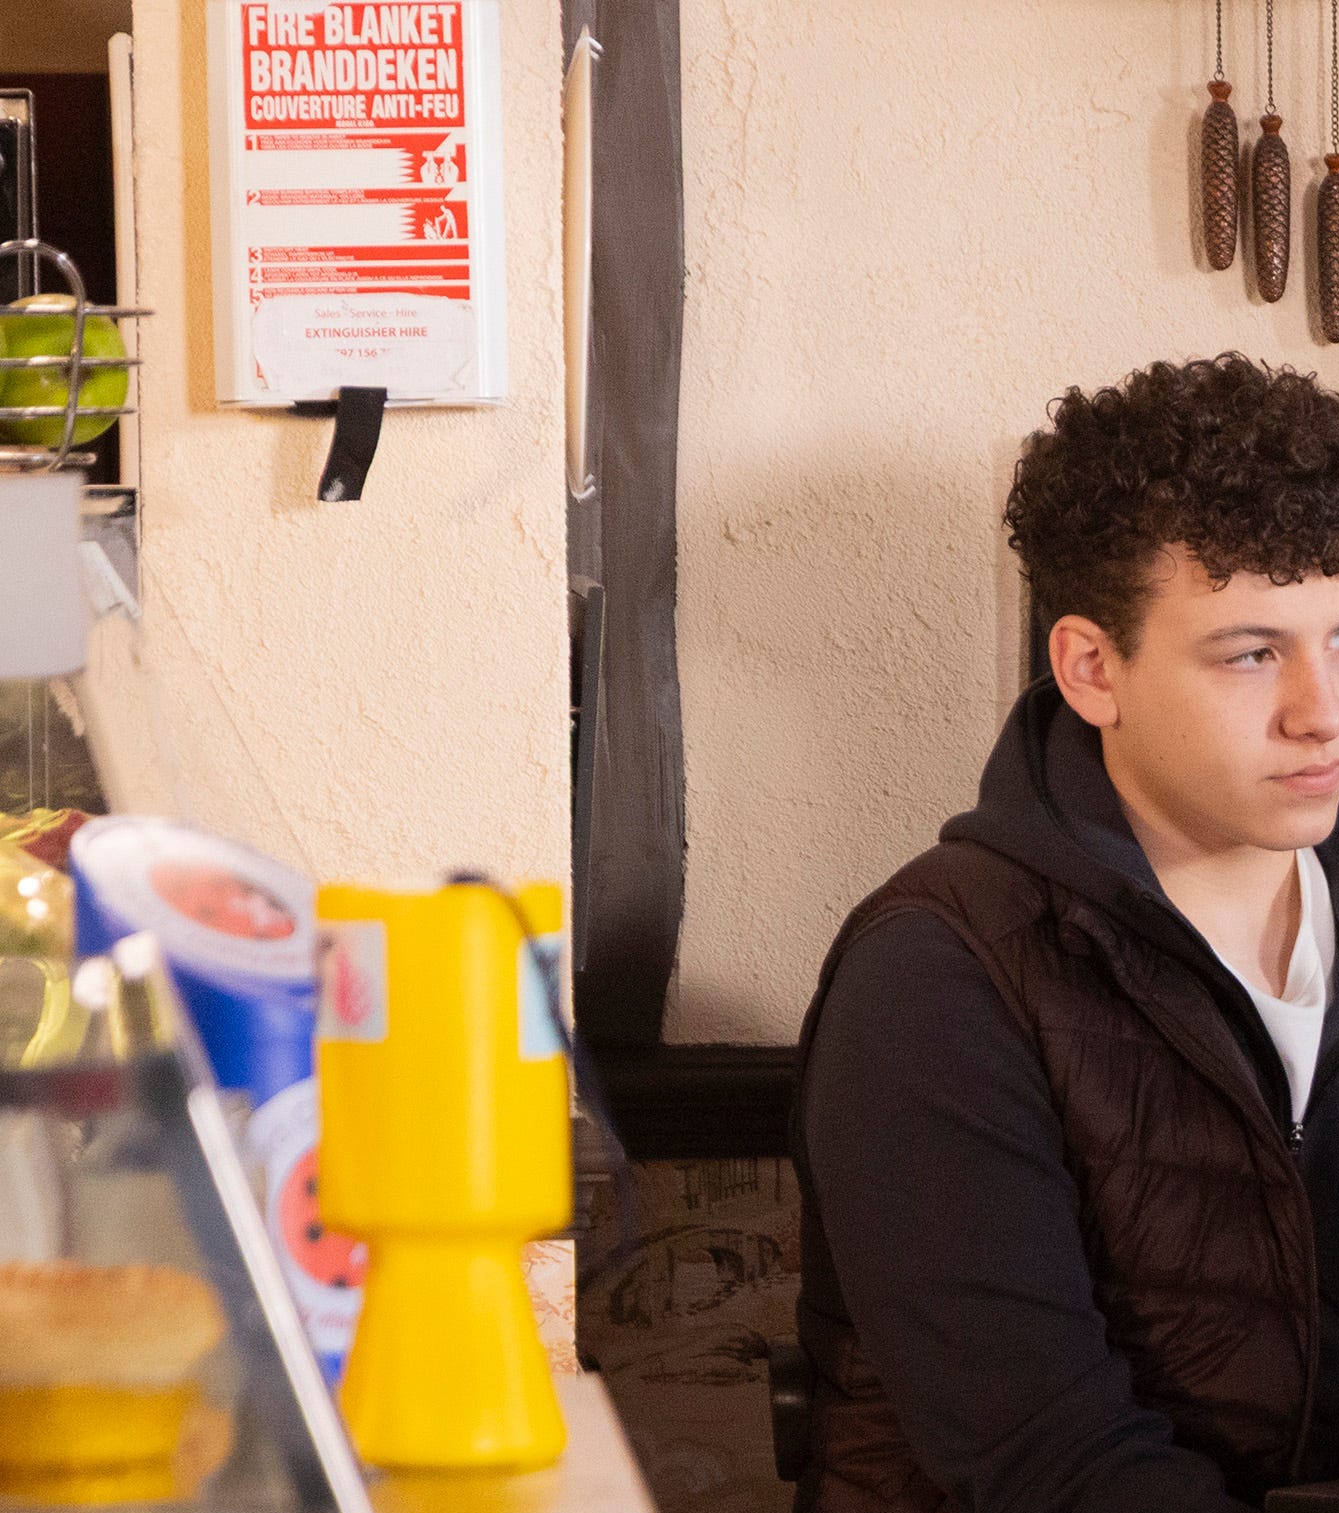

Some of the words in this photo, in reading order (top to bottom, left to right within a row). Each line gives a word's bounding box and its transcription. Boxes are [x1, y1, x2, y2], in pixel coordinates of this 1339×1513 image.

[249, 5, 317, 46] FIRE
[324, 4, 456, 46] BLANKET
[250, 48, 458, 92] BRANDDEKEN
[251, 94, 366, 121] COUVERTURE
[371, 93, 460, 120] ANTI-FEU
[250, 246, 263, 262] 3
[251, 266, 263, 283] 4
[314, 308, 341, 319] Sales
[349, 308, 388, 318] Service
[304, 327, 396, 339] EXTINGUISHER
[400, 326, 428, 338] HIRE
